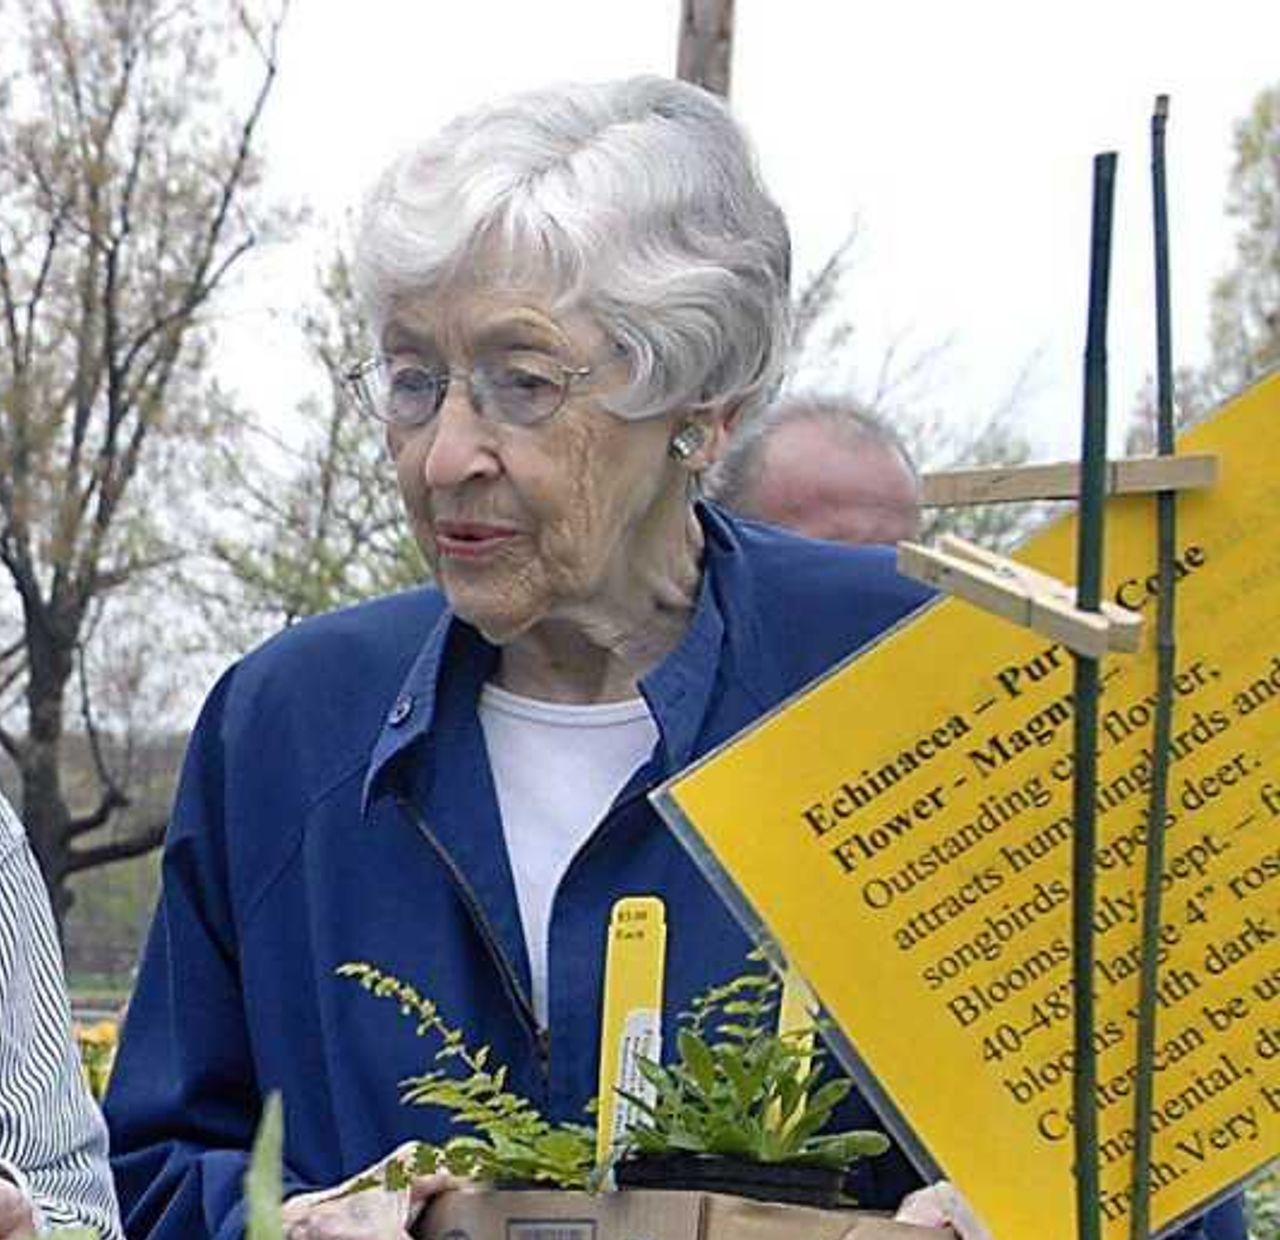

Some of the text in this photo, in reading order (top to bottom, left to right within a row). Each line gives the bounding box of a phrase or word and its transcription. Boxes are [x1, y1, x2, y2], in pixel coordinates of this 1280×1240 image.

[803, 714, 972, 838] Echinacea
[834, 787, 946, 874] Flower
[966, 678, 1105, 779] Magn
[894, 868, 1004, 951] attracts
[999, 709, 1231, 873] humingirds
[1092, 808, 1177, 870] epes
[1181, 751, 1263, 811] deer.
[862, 777, 1053, 909] Outstanding
[947, 937, 1070, 1027] Blooms
[1204, 916, 1277, 976] dark
[1037, 1063, 1140, 1142] Ceter
[1202, 996, 1250, 1032] be
